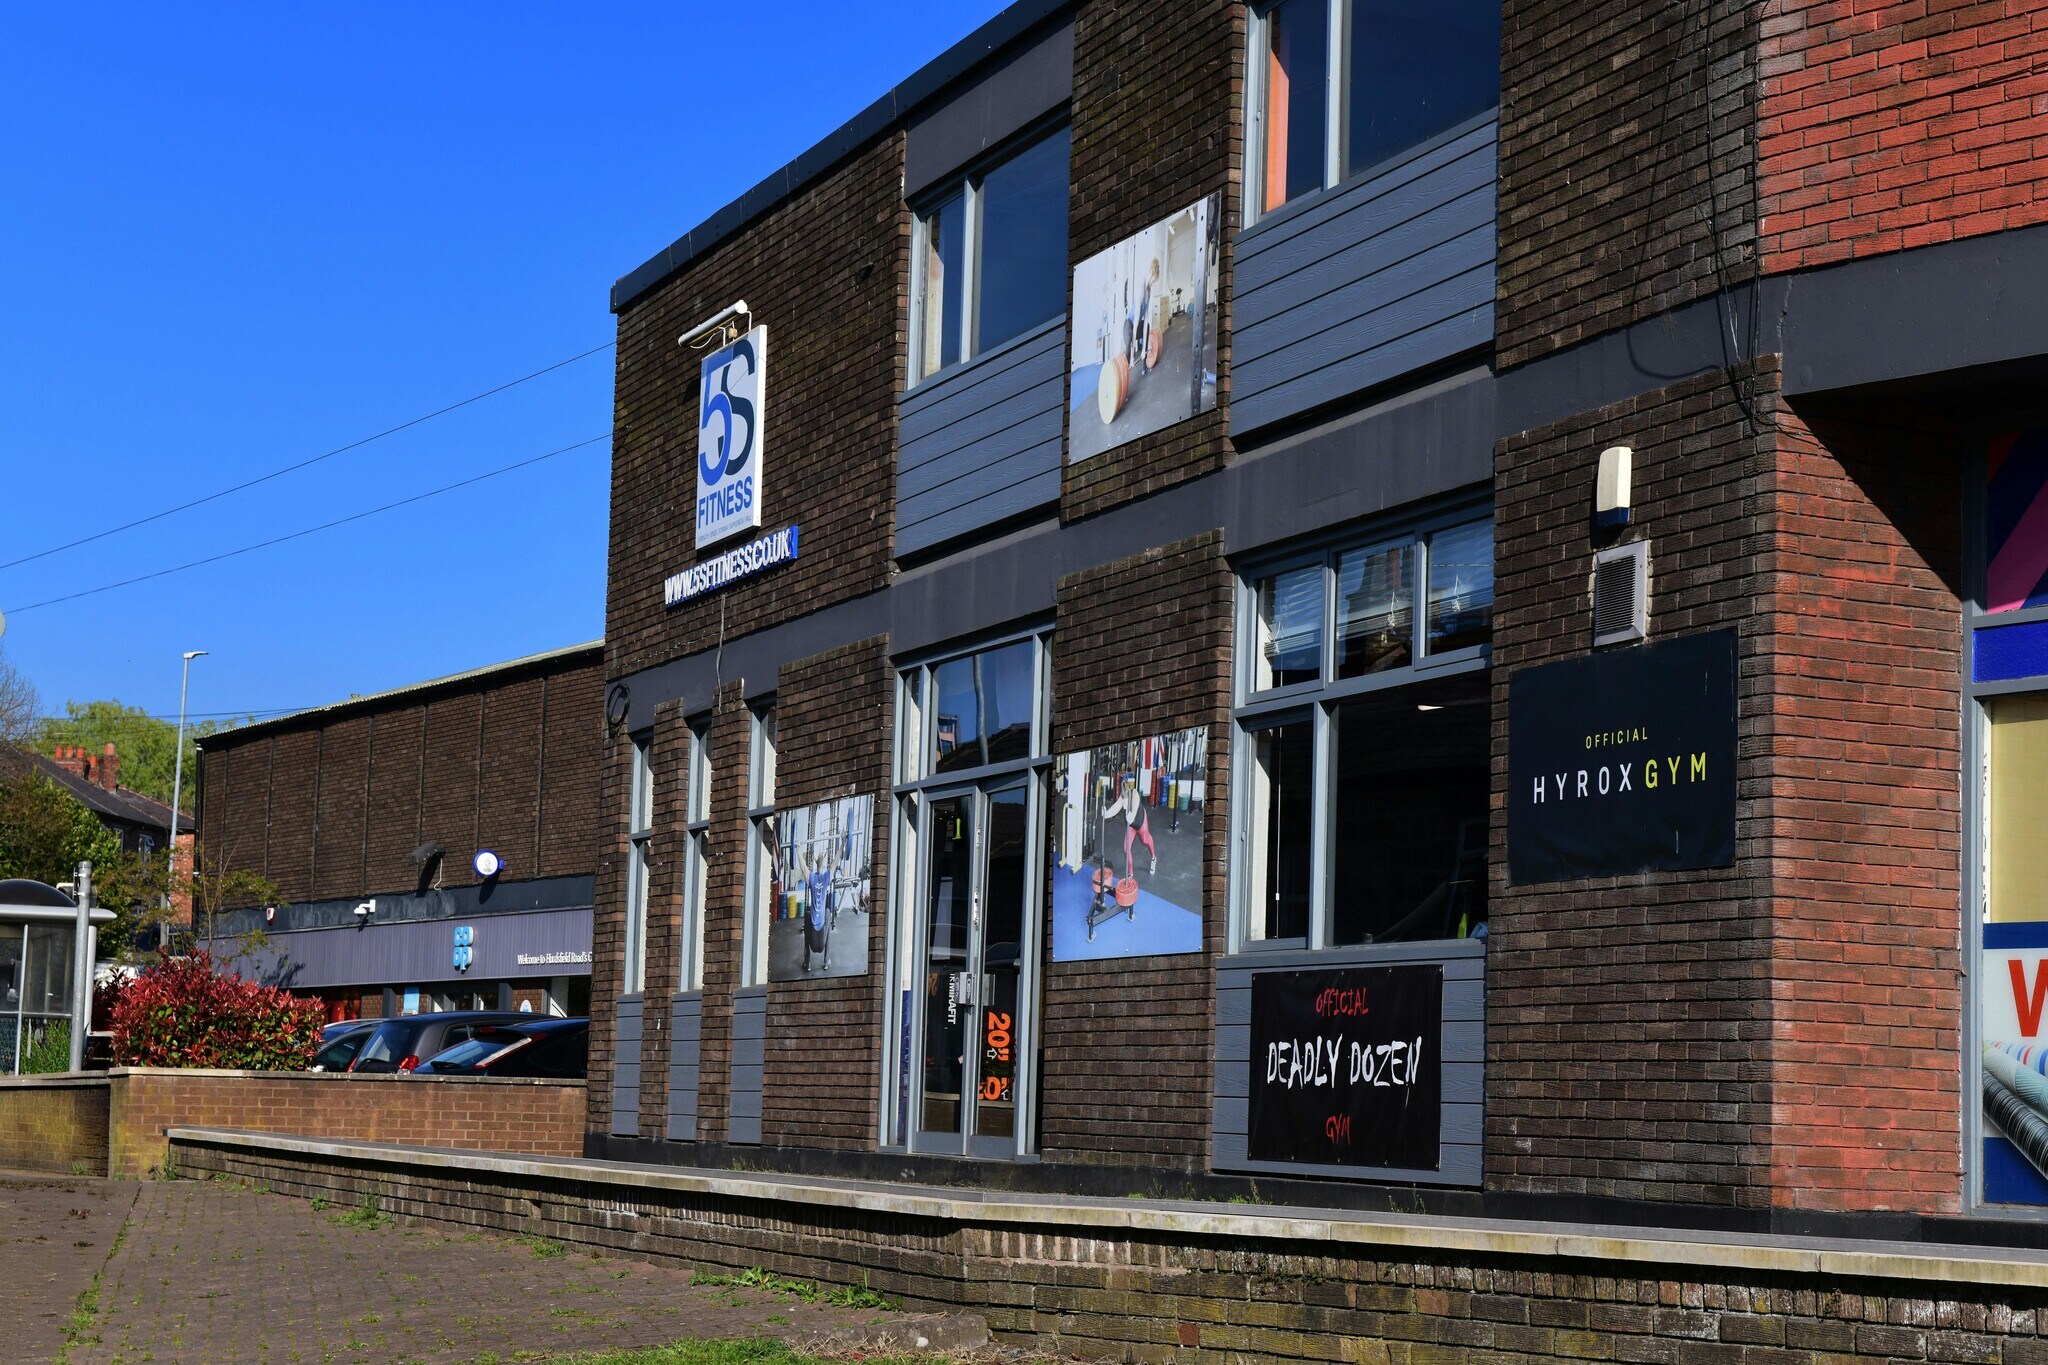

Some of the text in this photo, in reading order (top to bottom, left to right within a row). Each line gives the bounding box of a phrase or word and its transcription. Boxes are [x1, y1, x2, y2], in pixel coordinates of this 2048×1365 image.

[700, 339, 755, 486] 5S
[698, 475, 753, 529] FITNESS
[1585, 726, 1648, 749] OFFICIAL
[517, 953, 539, 965] Welcome
[539, 954, 546, 964] to
[1315, 986, 1369, 1017] OFFICIAL
[1267, 1033, 1422, 1089] DEADLY DOZEN
[1325, 1112, 1350, 1145] GYM
